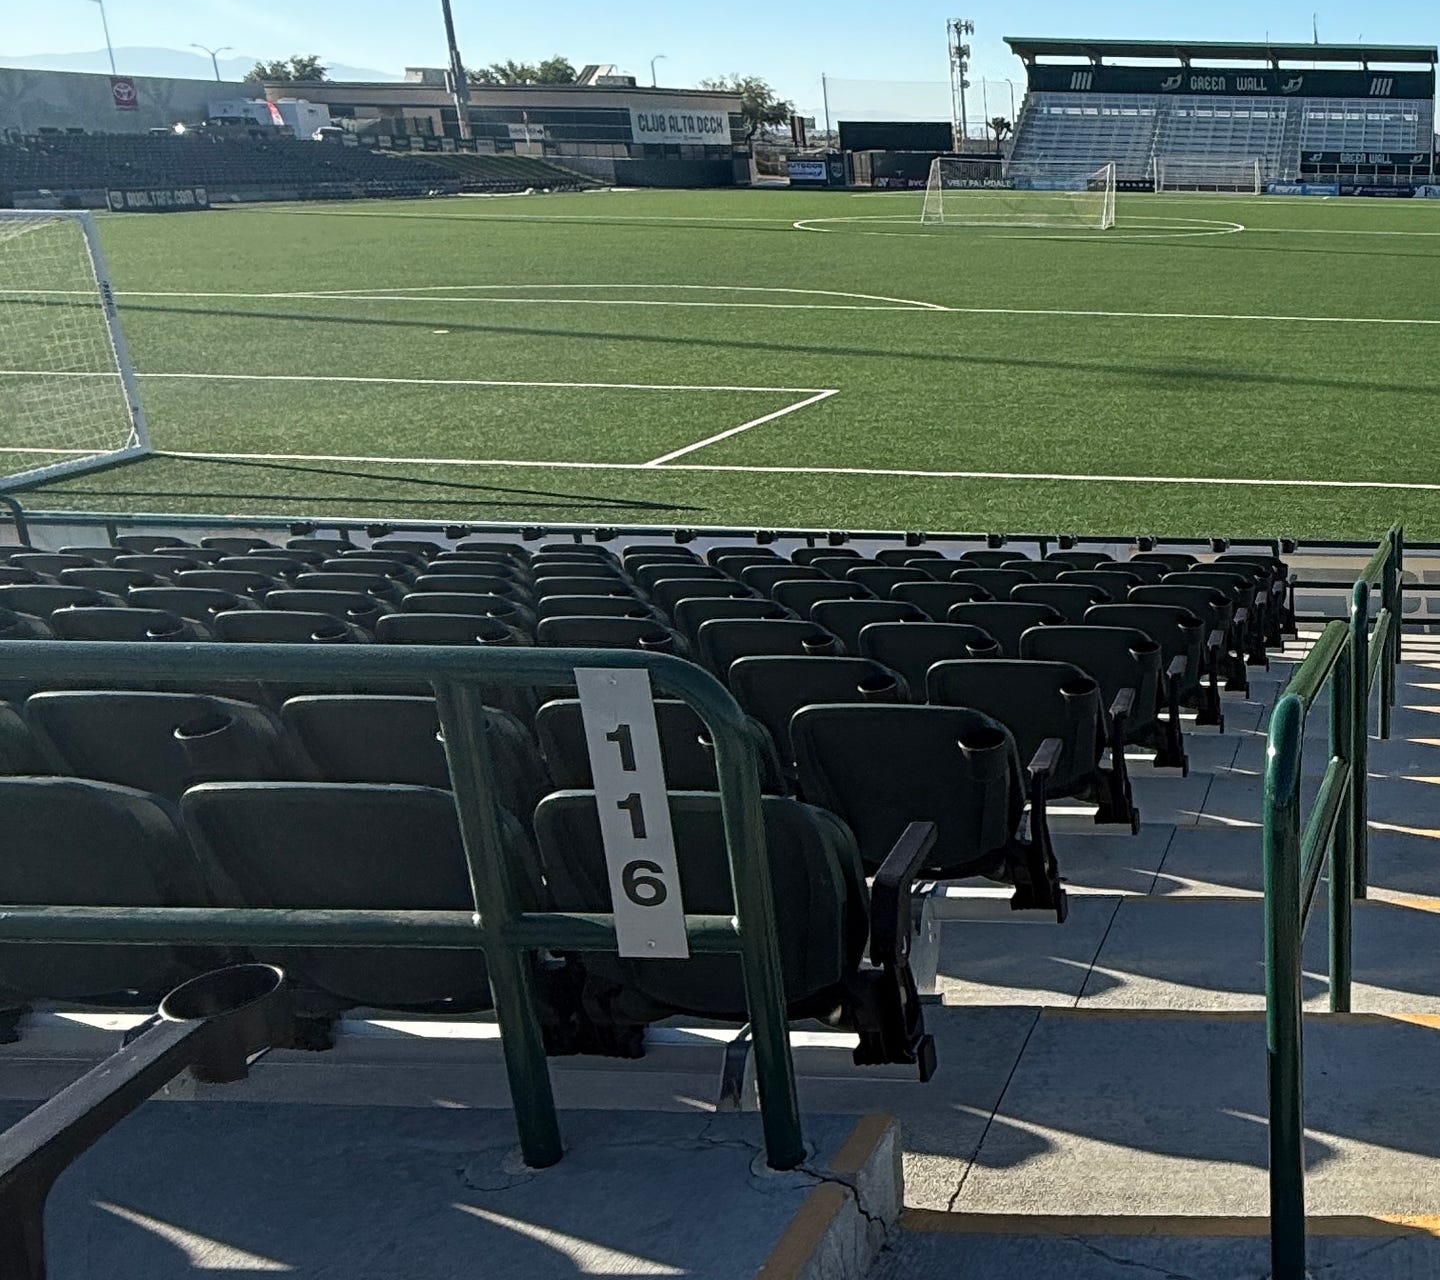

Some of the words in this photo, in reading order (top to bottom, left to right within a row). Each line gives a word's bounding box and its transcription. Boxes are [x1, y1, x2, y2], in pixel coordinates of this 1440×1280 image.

[1190, 76, 1225, 91] GREEN
[1236, 77, 1267, 91] WALL
[638, 114, 666, 132] CLUB
[668, 115, 695, 133] ALTA
[697, 116, 724, 134] DECK
[1340, 153, 1366, 164] GREEN
[1369, 154, 1392, 164] WALL
[605, 724, 668, 907] 116
